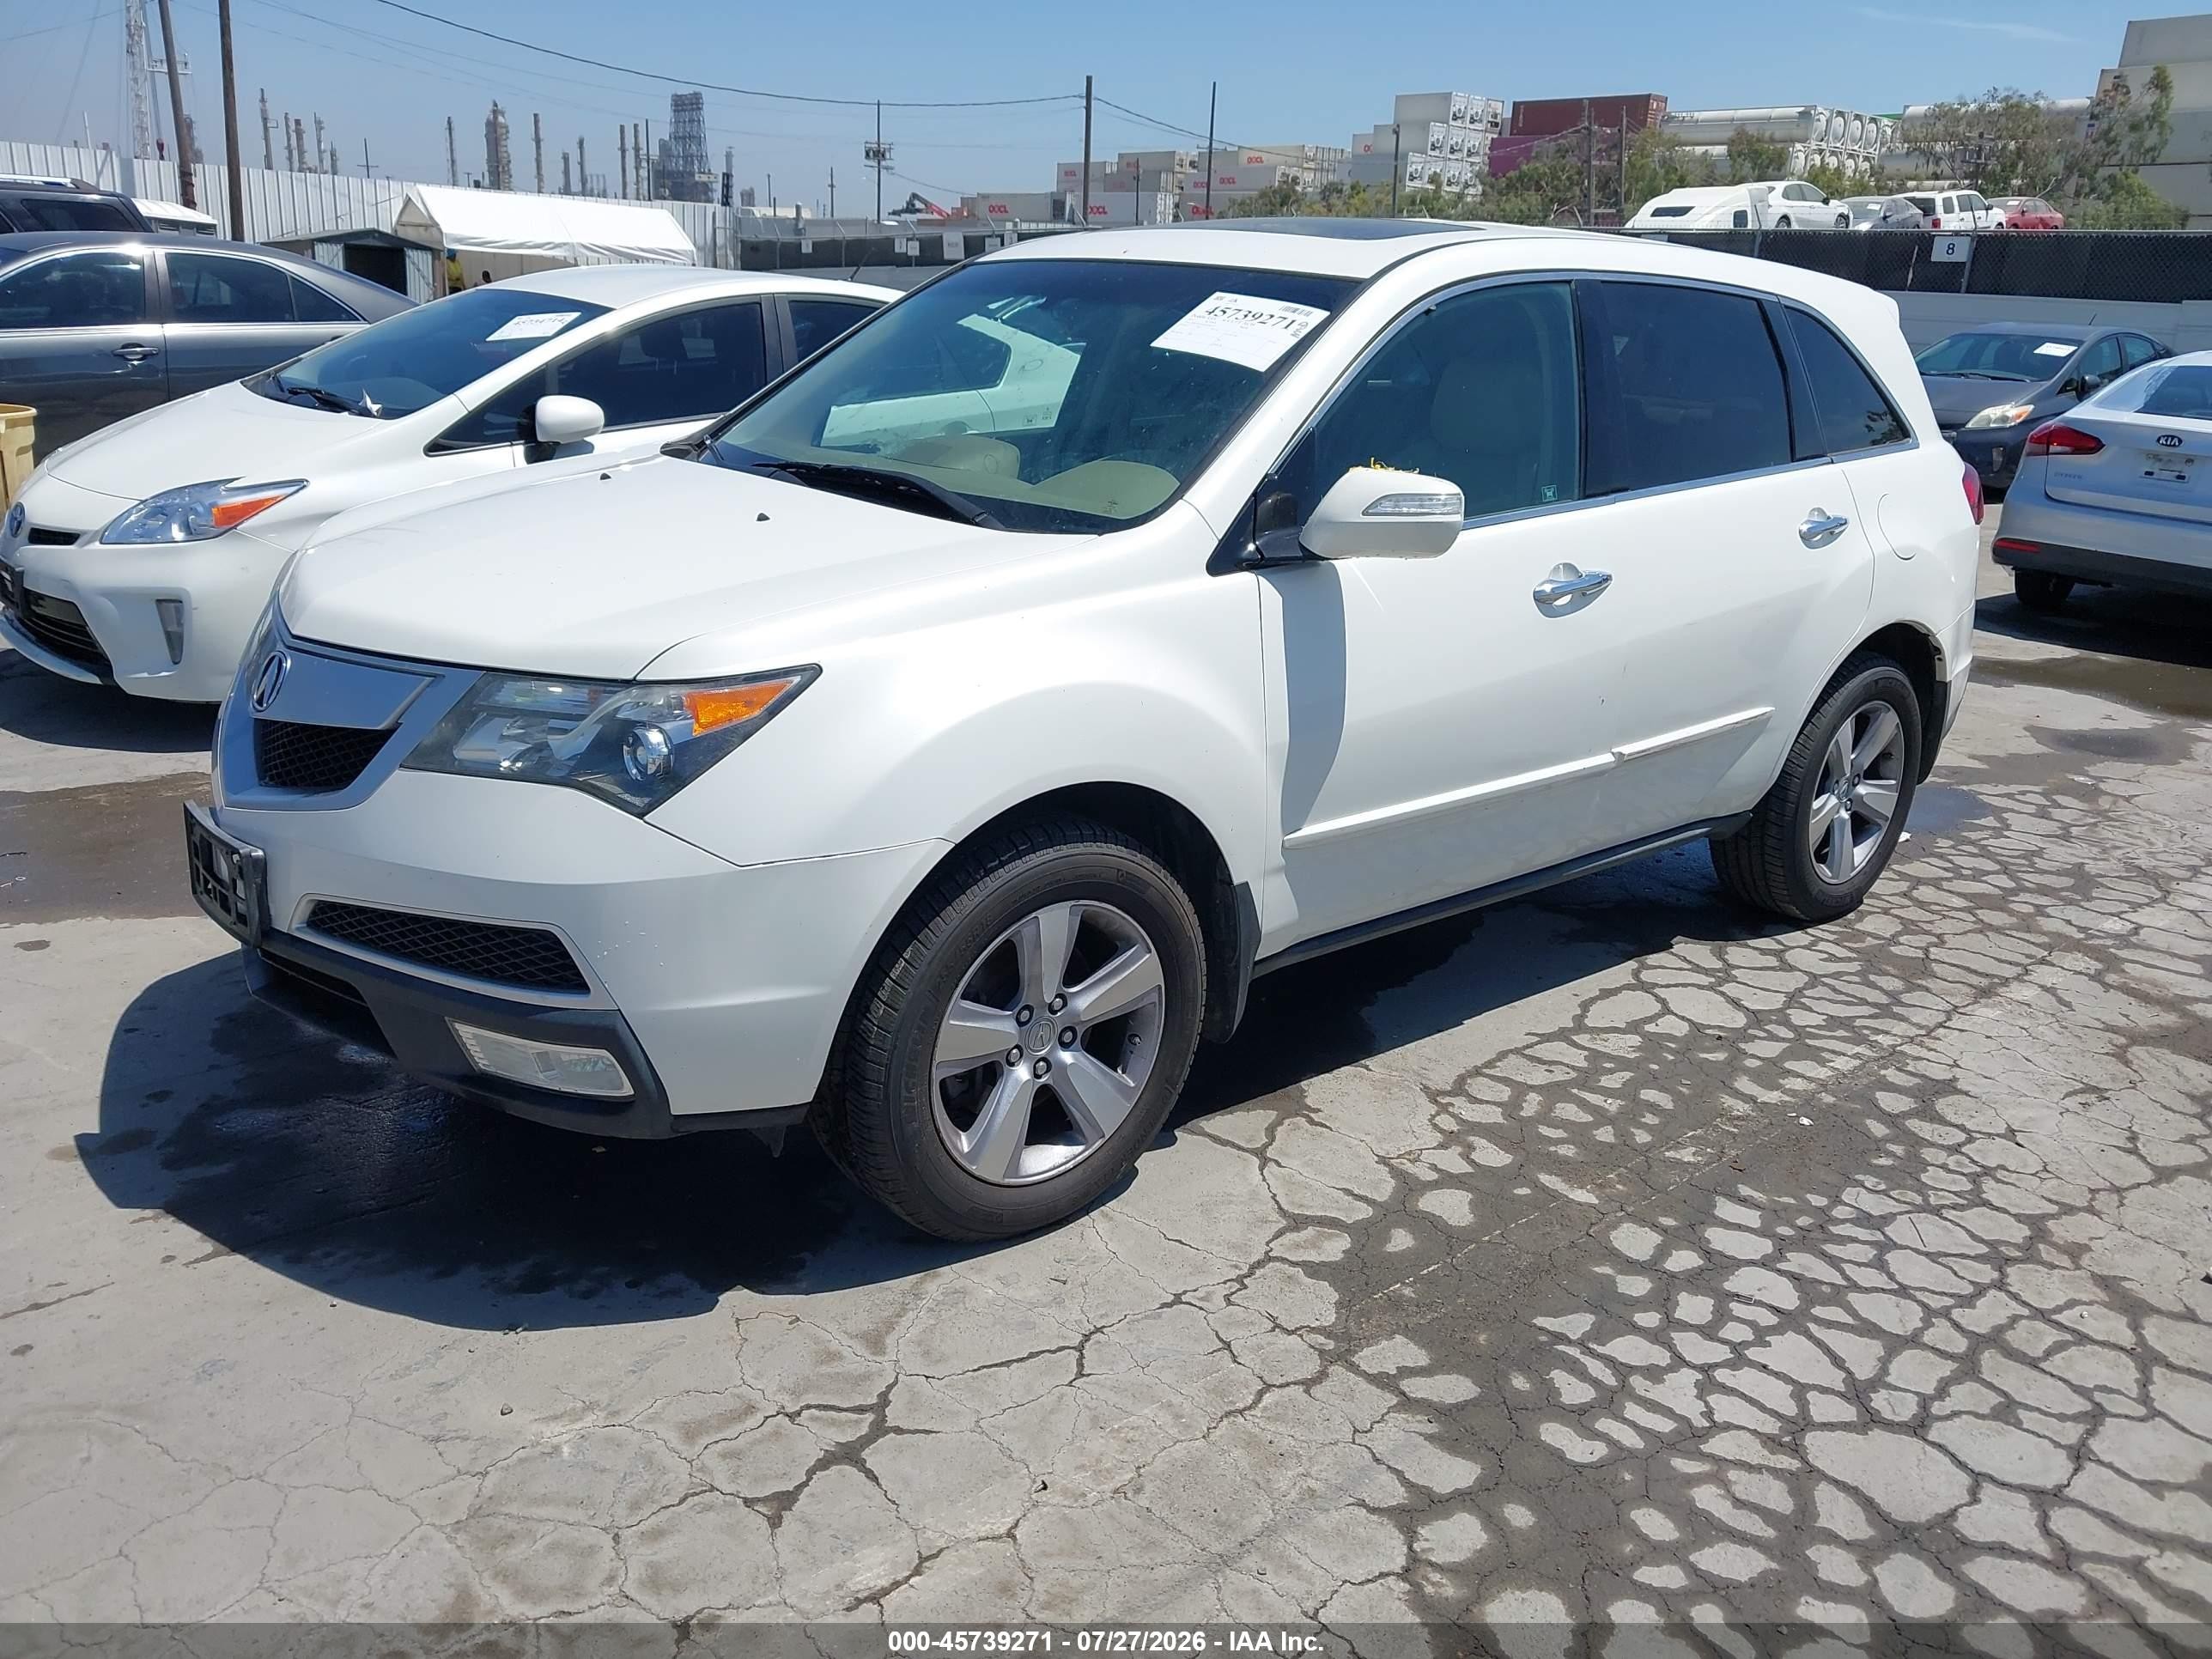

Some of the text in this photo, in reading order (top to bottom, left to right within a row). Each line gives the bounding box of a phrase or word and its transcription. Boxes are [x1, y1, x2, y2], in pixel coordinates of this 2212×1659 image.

[988, 204, 1009, 214] OOCL
[1088, 205, 1108, 215] OCL
[1191, 205, 1214, 216] OL
[1946, 242, 1955, 256] 8
[1206, 307, 1297, 329] 45739271
[2159, 436, 2179, 446] KIA
